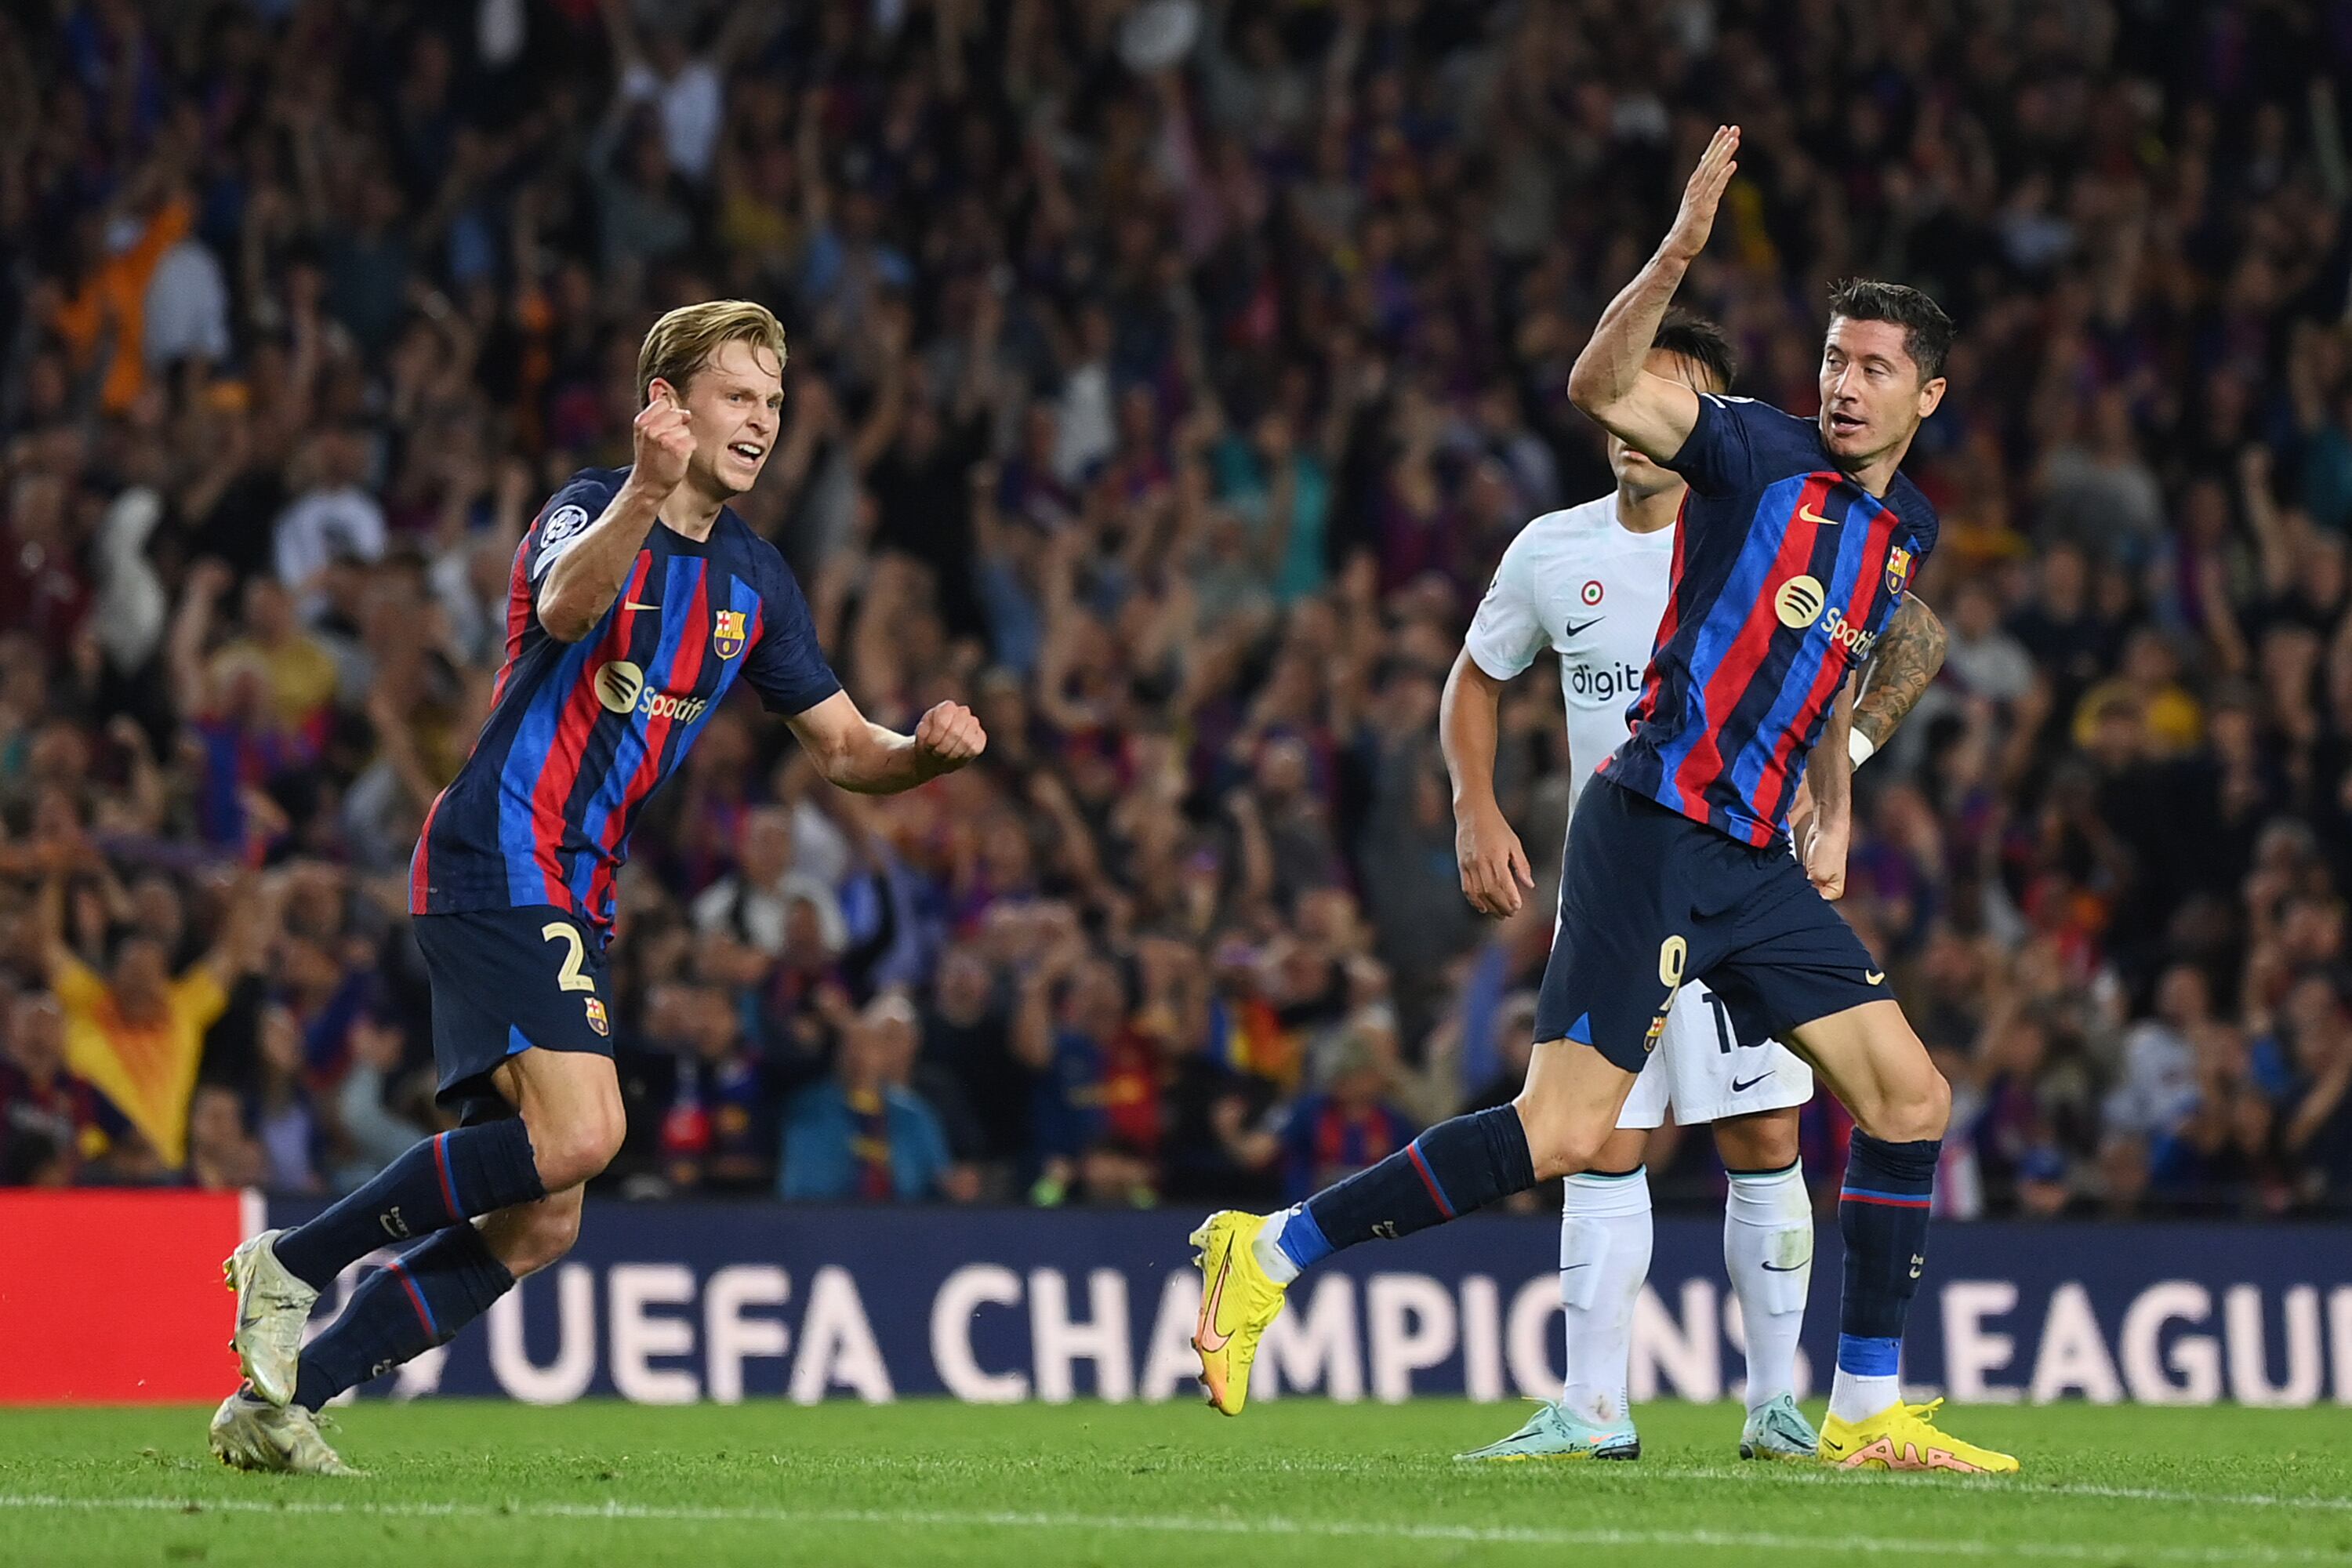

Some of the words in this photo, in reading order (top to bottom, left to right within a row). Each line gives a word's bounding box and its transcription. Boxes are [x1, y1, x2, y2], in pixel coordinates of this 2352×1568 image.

[1573, 662, 1639, 701] digit
[541, 922, 595, 993] 2
[1659, 935, 1686, 1011] 9
[488, 1261, 897, 1406] UEFA
[1899, 1279, 2352, 1406] EAGU
